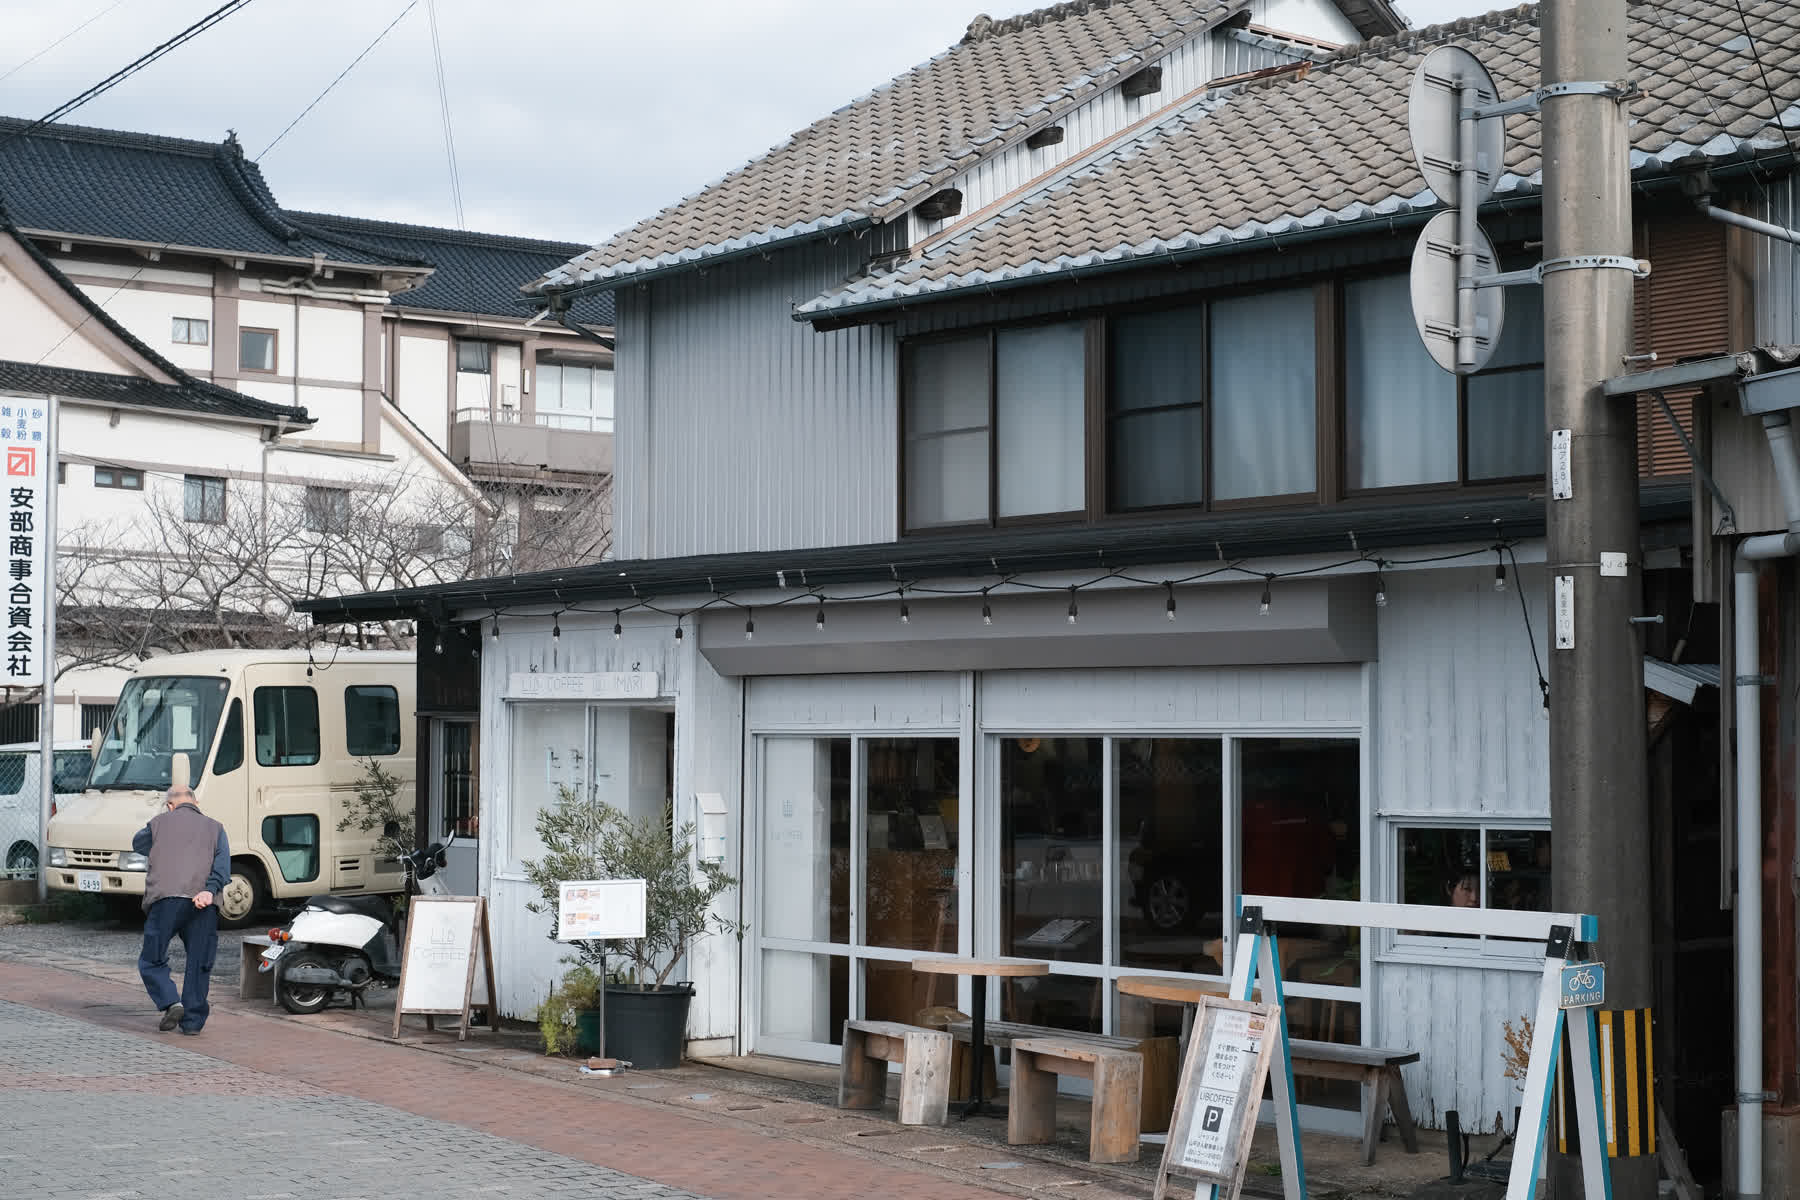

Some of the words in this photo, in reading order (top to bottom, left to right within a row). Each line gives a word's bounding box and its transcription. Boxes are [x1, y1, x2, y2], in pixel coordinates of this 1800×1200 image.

[7, 487, 34, 676] 安部商事合資会社
[1564, 991, 1601, 1005] PARKING
[1199, 1091, 1235, 1105] LIBCOFFEE
